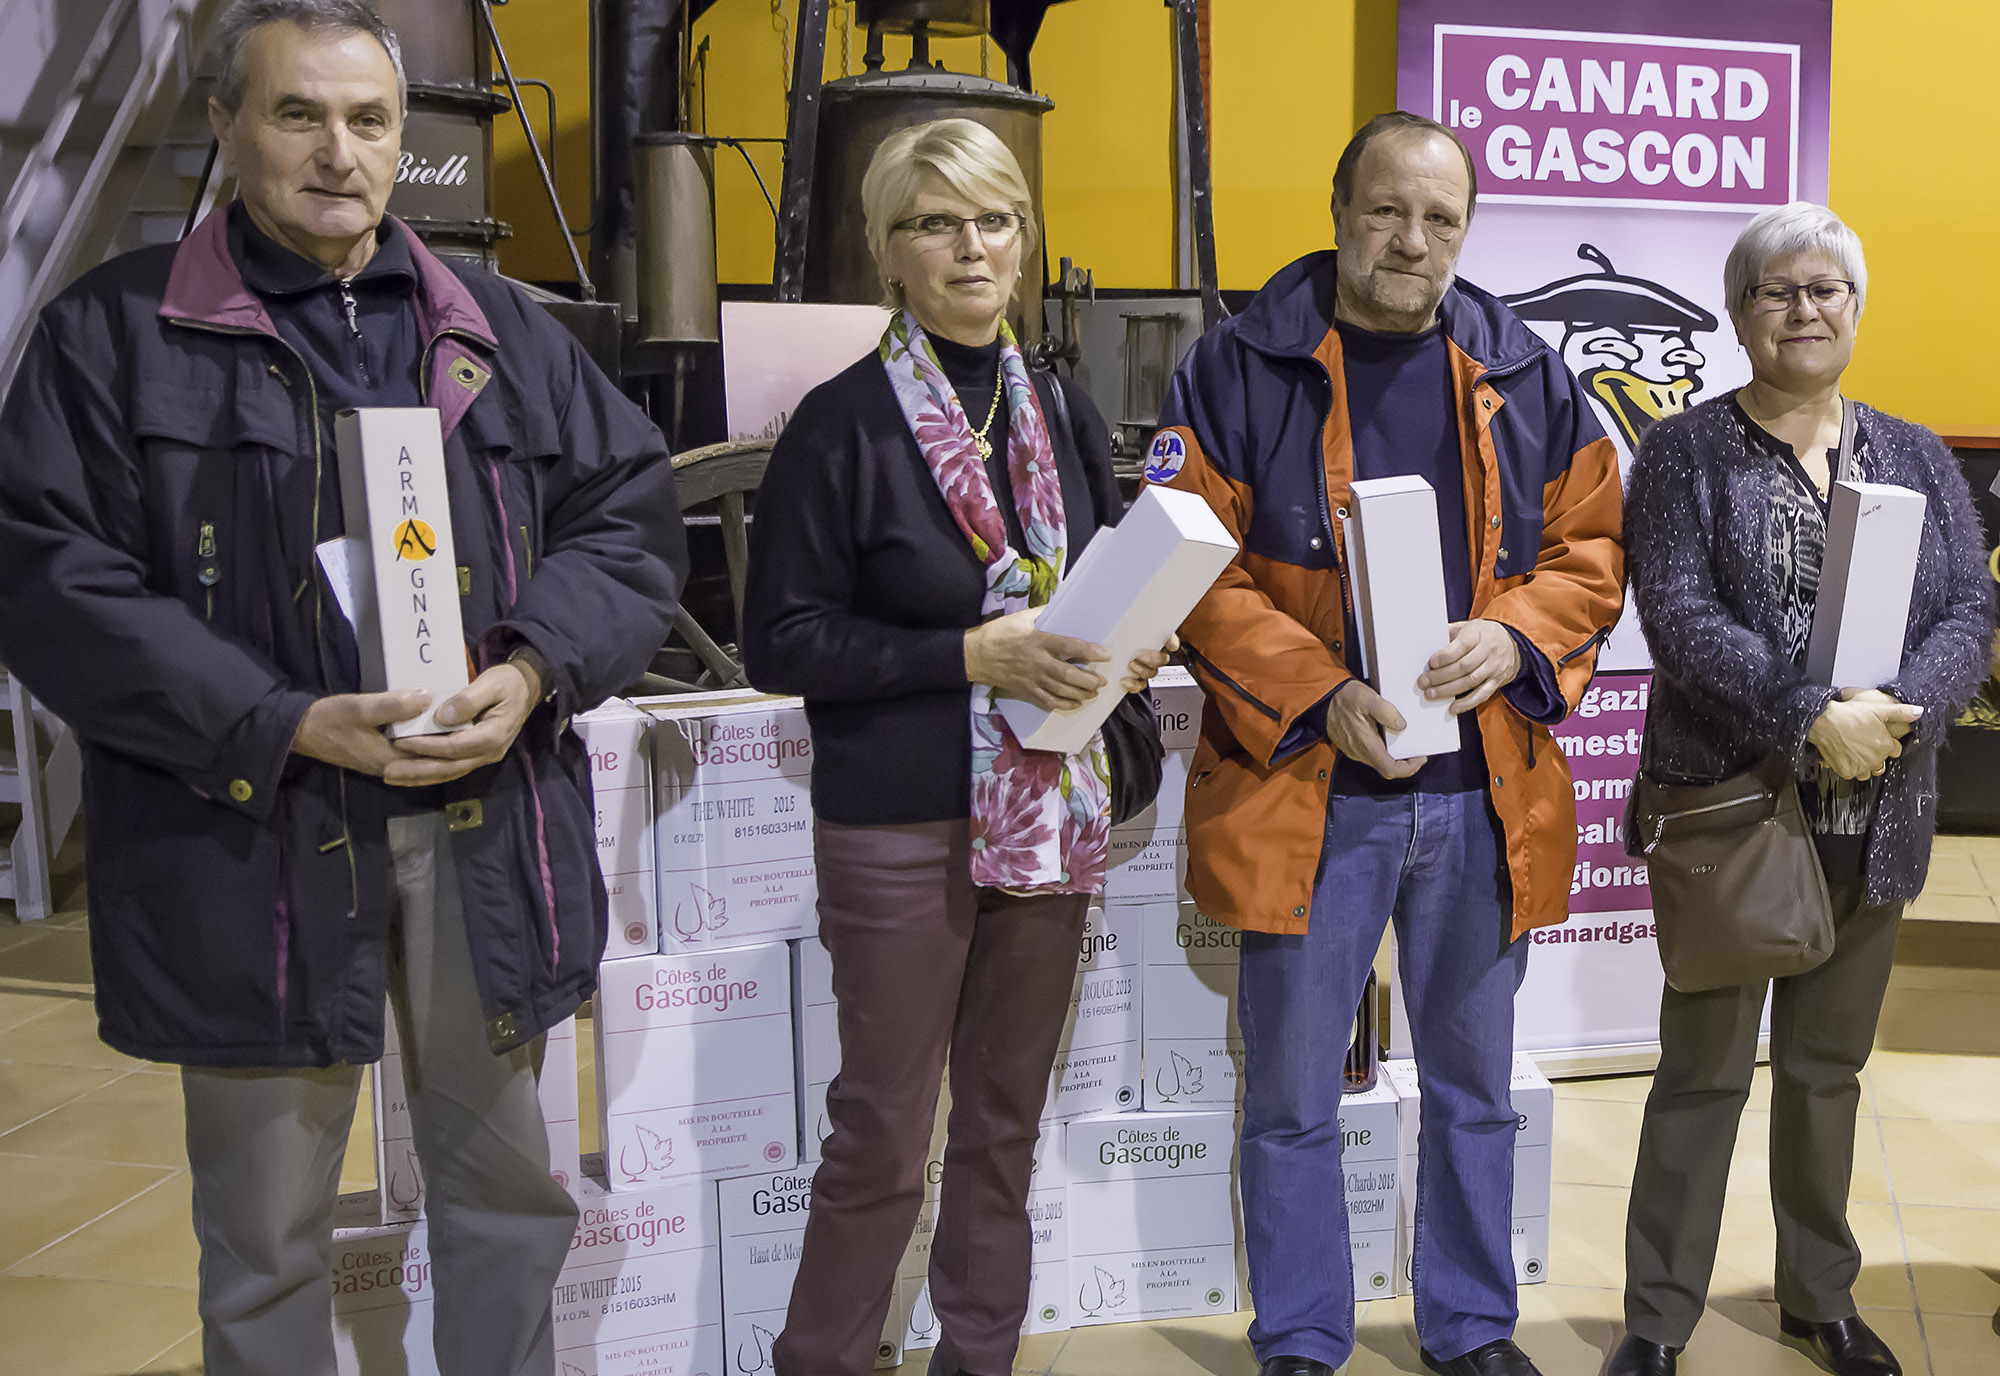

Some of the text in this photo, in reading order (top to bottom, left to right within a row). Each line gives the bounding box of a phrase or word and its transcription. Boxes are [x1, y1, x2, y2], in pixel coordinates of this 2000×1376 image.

[1485, 54, 1770, 122] CANARD
[1449, 99, 1483, 129] le
[1484, 124, 1766, 190] GASCON
[1573, 683, 1648, 718] gazi
[710, 719, 780, 742] Côtes de
[692, 737, 811, 769] Gascogne
[1550, 728, 1643, 757] mest
[691, 795, 796, 822] THE WHITE 2015
[734, 820, 807, 838] 81516033HM
[1112, 841, 1128, 849] MIS
[1142, 839, 1187, 848] BOUTEILL
[732, 868, 815, 885] MIS EN BOUTEILLE
[1570, 861, 1649, 895] giona
[655, 963, 727, 986] Côtes de
[635, 980, 758, 1012] Gascogne
[1084, 978, 1132, 1001] ROUGE 2015
[1073, 1055, 1117, 1068] BOUTEILLE
[1117, 1126, 1180, 1145] Côtes de
[1099, 1141, 1207, 1169] Gascogne
[772, 1175, 813, 1193] Côtes
[1378, 1173, 1395, 1190] 2015
[583, 1200, 655, 1226] Côtes de
[1045, 1202, 1063, 1220] 2015
[400, 1242, 420, 1262] de
[749, 1246, 769, 1264] Haut
[771, 1243, 781, 1262] de
[1160, 1256, 1207, 1267] BOUTEILLE
[555, 1275, 642, 1306] THE WHITE 2015
[601, 1292, 676, 1315] 81516033HM
